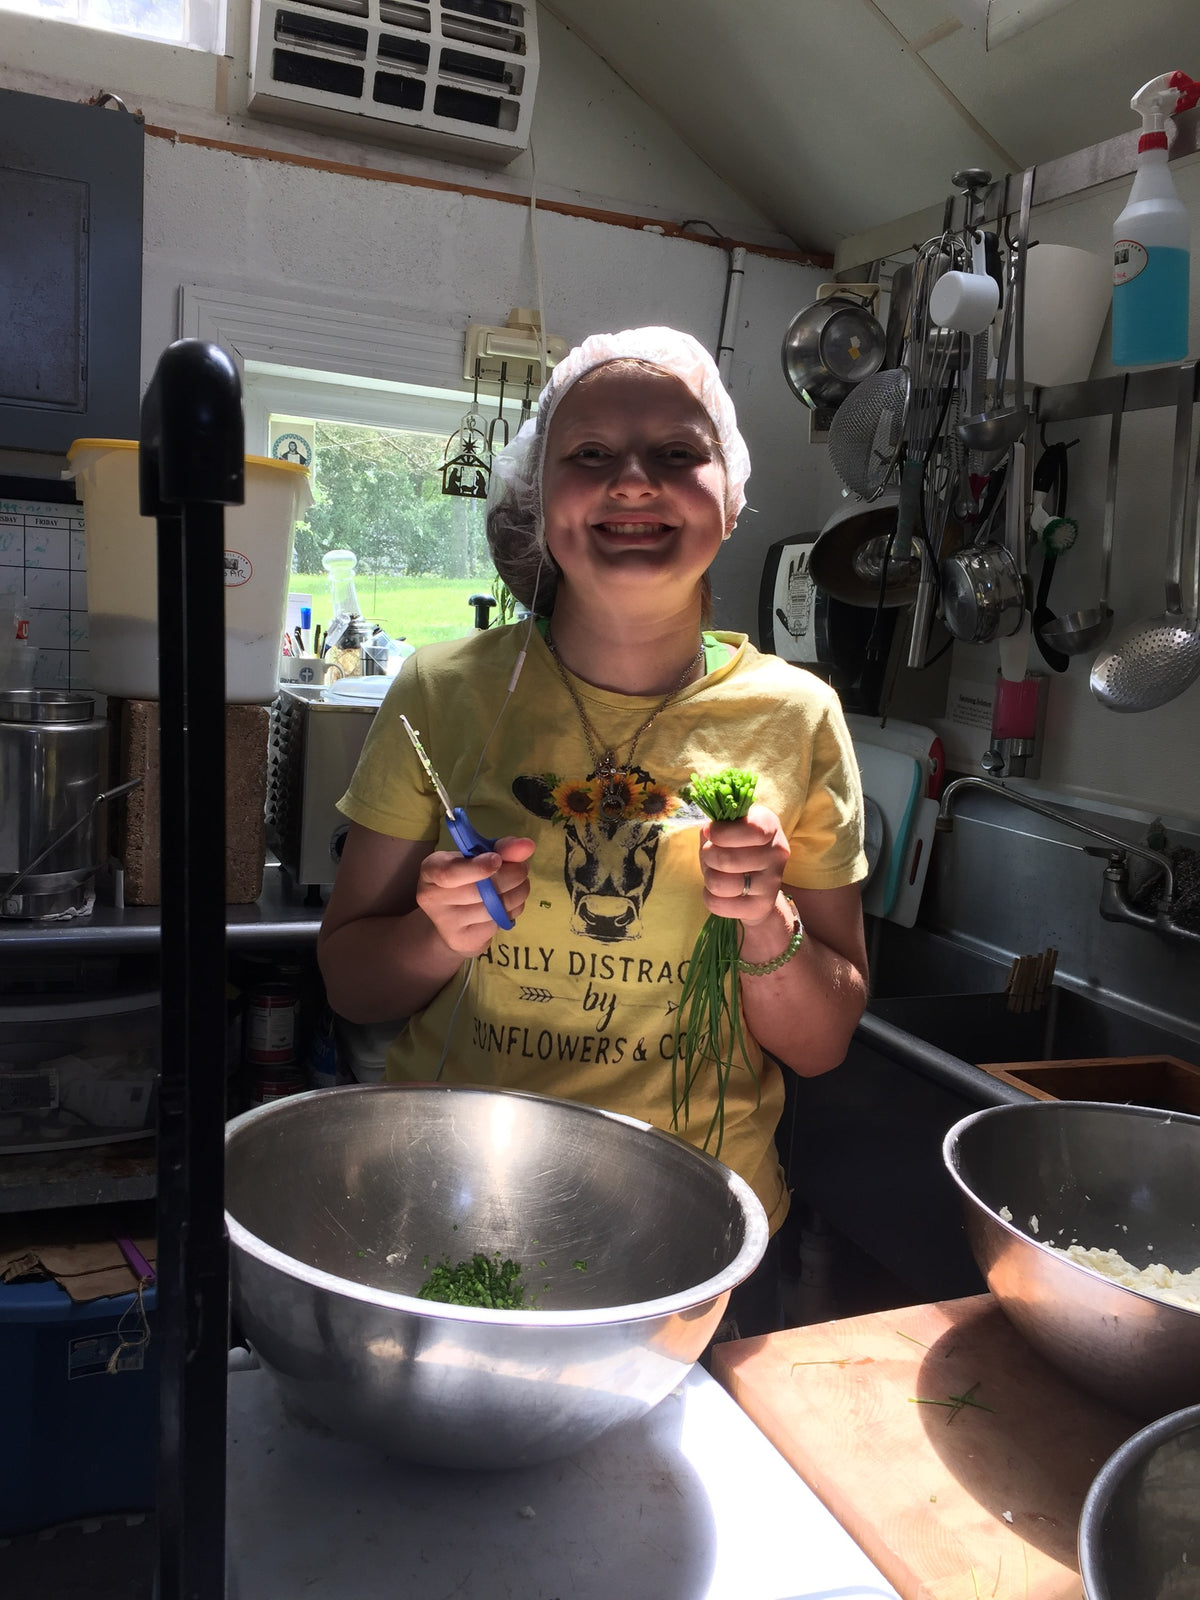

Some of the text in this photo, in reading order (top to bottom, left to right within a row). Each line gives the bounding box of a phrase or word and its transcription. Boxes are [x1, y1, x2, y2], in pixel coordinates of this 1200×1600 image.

[35, 518, 58, 526] FRIDAY
[478, 943, 692, 985] ASILY DISTRAC
[582, 981, 617, 1033] by
[632, 1036, 648, 1062] &
